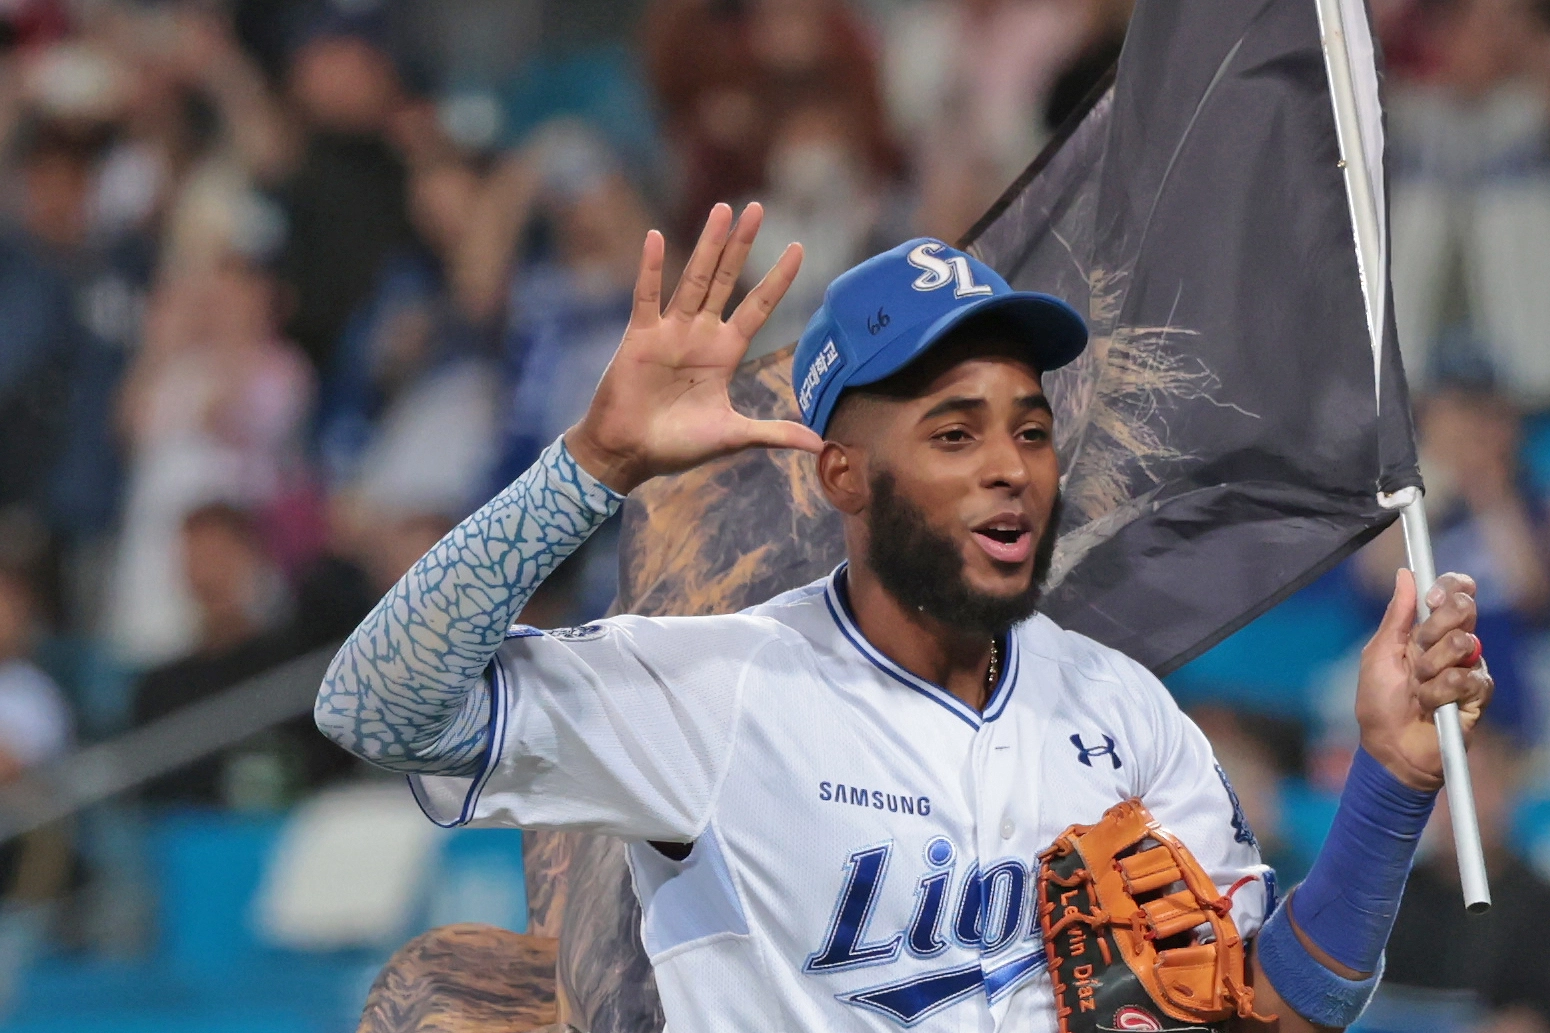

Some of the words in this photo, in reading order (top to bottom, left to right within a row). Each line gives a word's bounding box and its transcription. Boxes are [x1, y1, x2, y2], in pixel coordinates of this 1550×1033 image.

[866, 306, 891, 337] 66
[818, 781, 931, 817] SAMSUNG
[803, 835, 1044, 974] Lio
[1073, 963, 1100, 1013] Diaz
